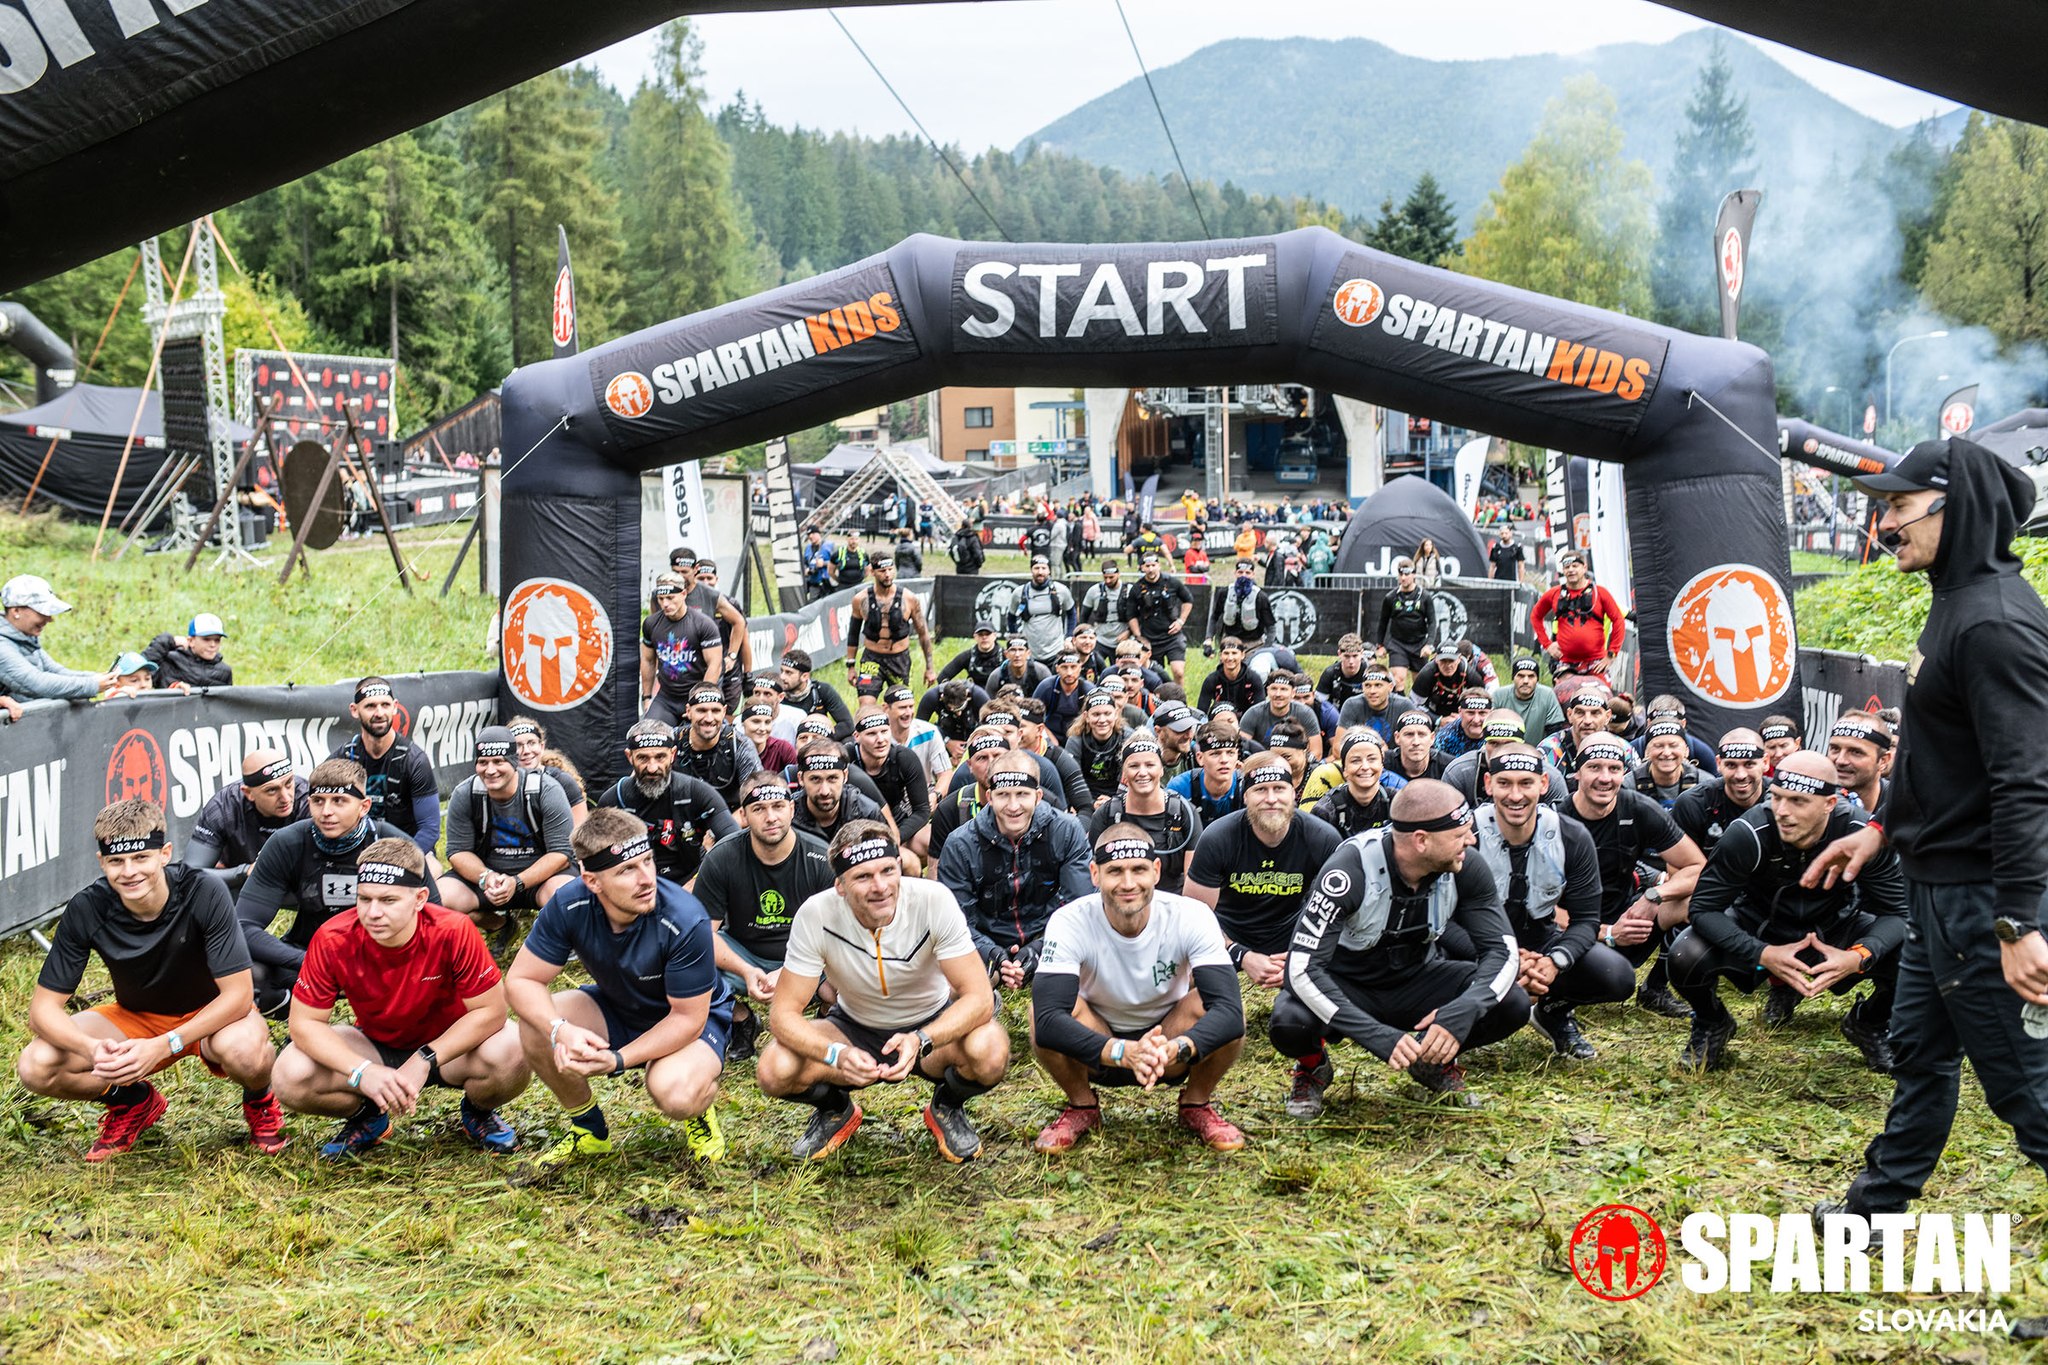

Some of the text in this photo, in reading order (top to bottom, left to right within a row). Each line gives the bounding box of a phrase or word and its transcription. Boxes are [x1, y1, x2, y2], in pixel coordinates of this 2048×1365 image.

[963, 255, 1267, 338] START
[849, 848, 885, 864] 30499
[1230, 871, 1304, 887] UNDER
[1229, 882, 1303, 896] ARMOUR
